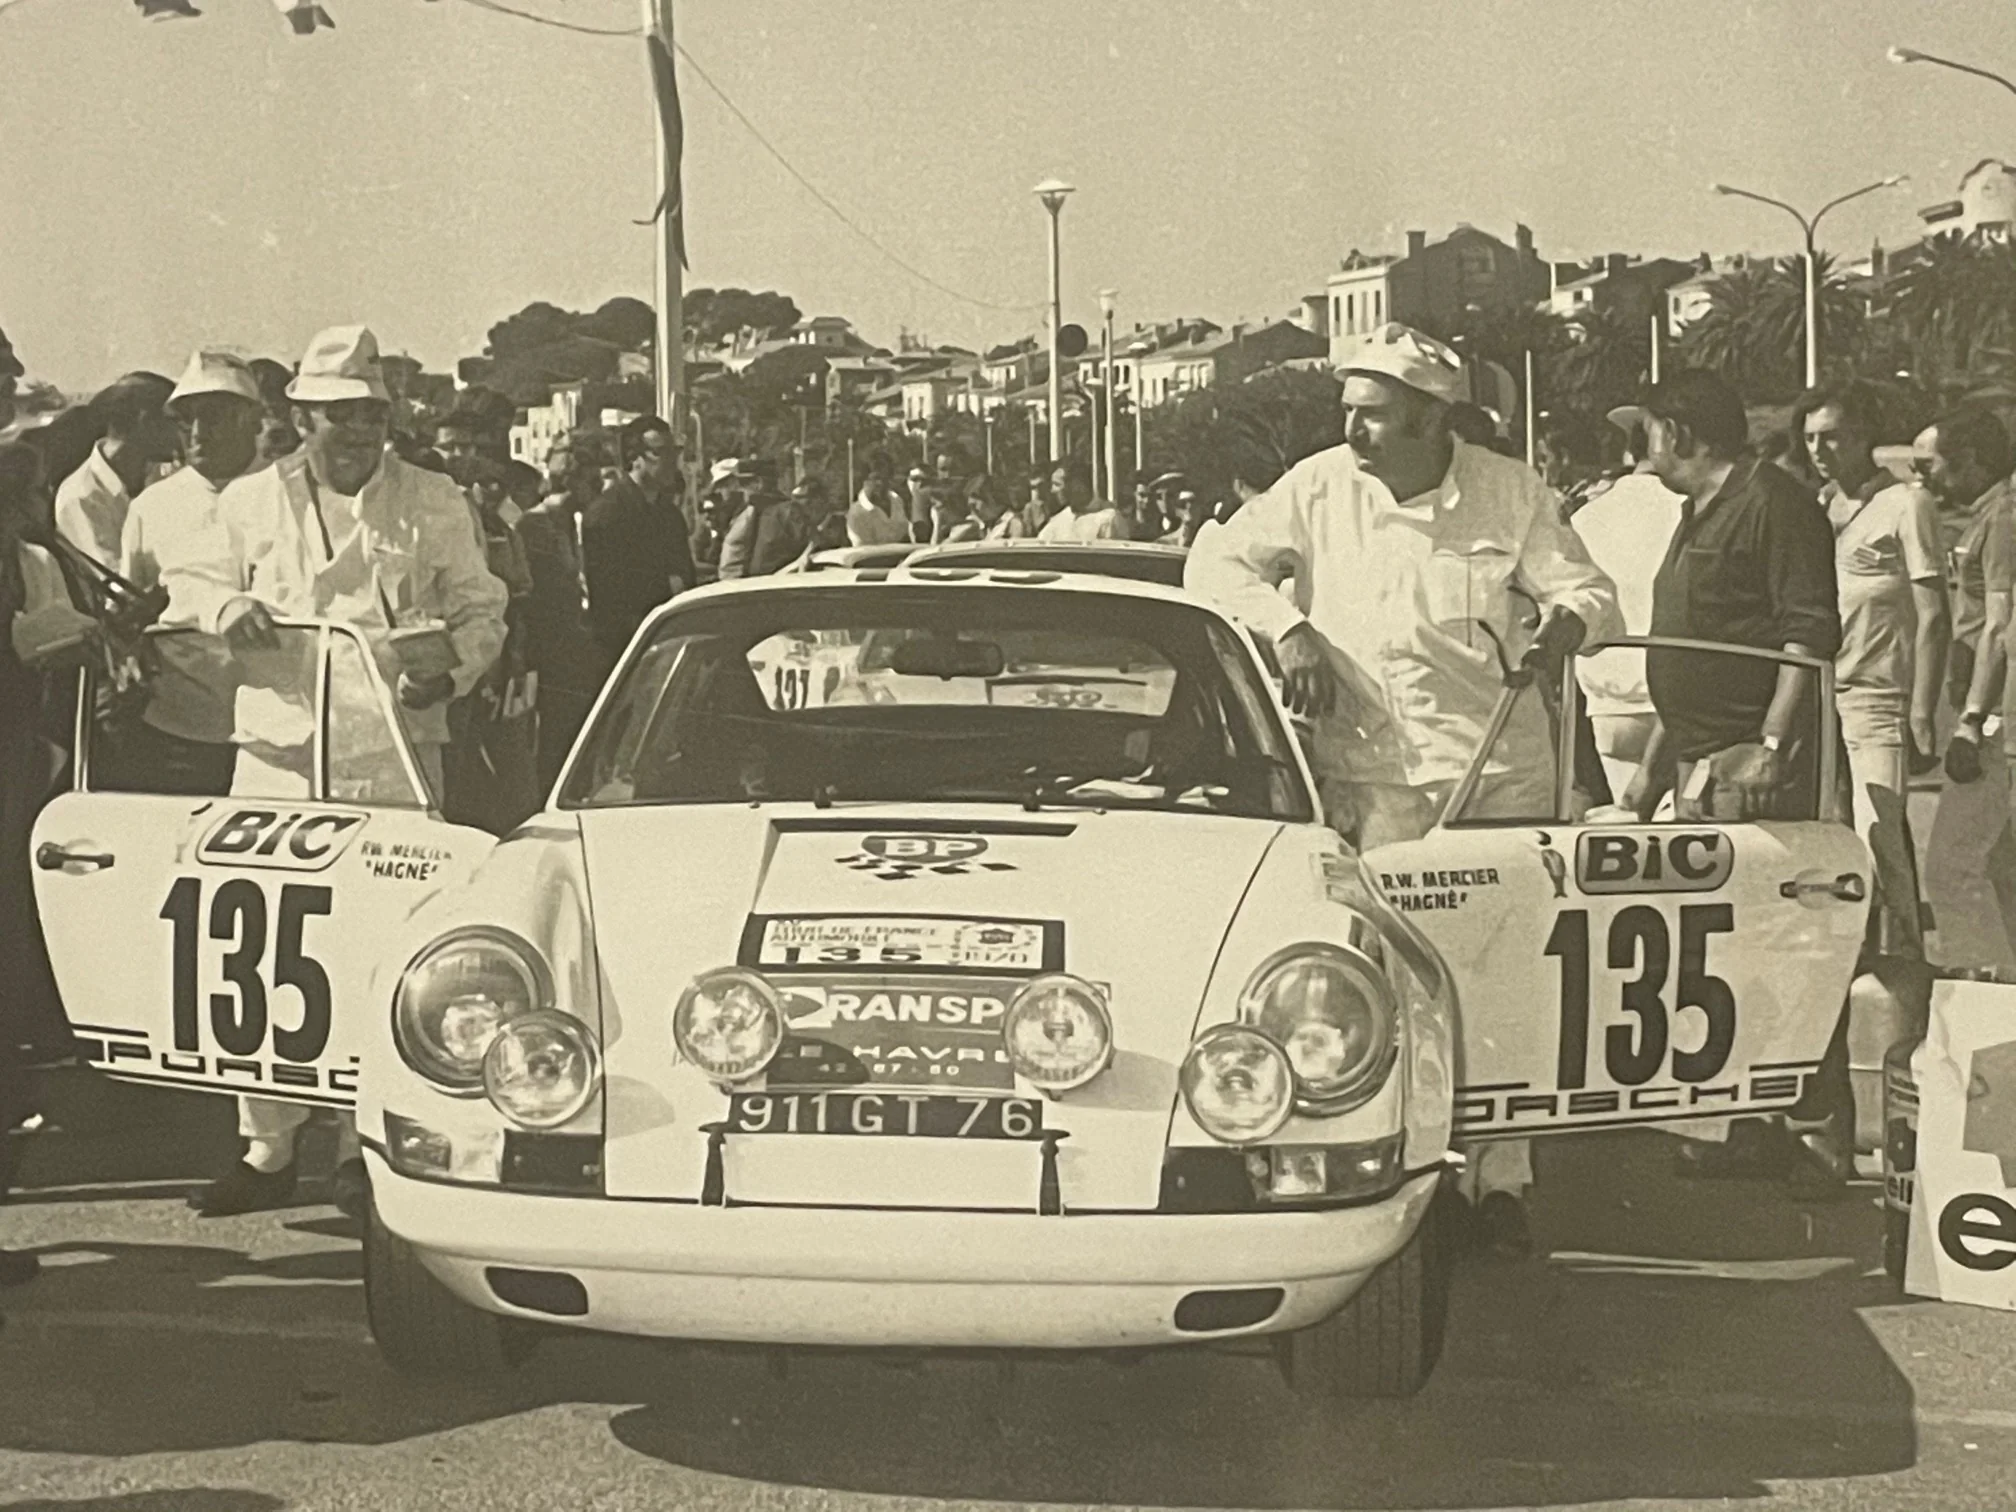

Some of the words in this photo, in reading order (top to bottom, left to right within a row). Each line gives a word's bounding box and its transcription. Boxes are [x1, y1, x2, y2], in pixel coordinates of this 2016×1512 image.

[886, 839, 977, 857] BP
[1422, 868, 1500, 888] MERCIER
[159, 876, 333, 1064] 135
[785, 947, 923, 965] 135
[783, 987, 1005, 1028] RANSP
[1543, 902, 1737, 1090] 135
[106, 1041, 359, 1092] PORSC
[738, 1096, 828, 1132] 911
[957, 1099, 1034, 1137] 76
[1454, 1075, 1798, 1123] ORSCHE
